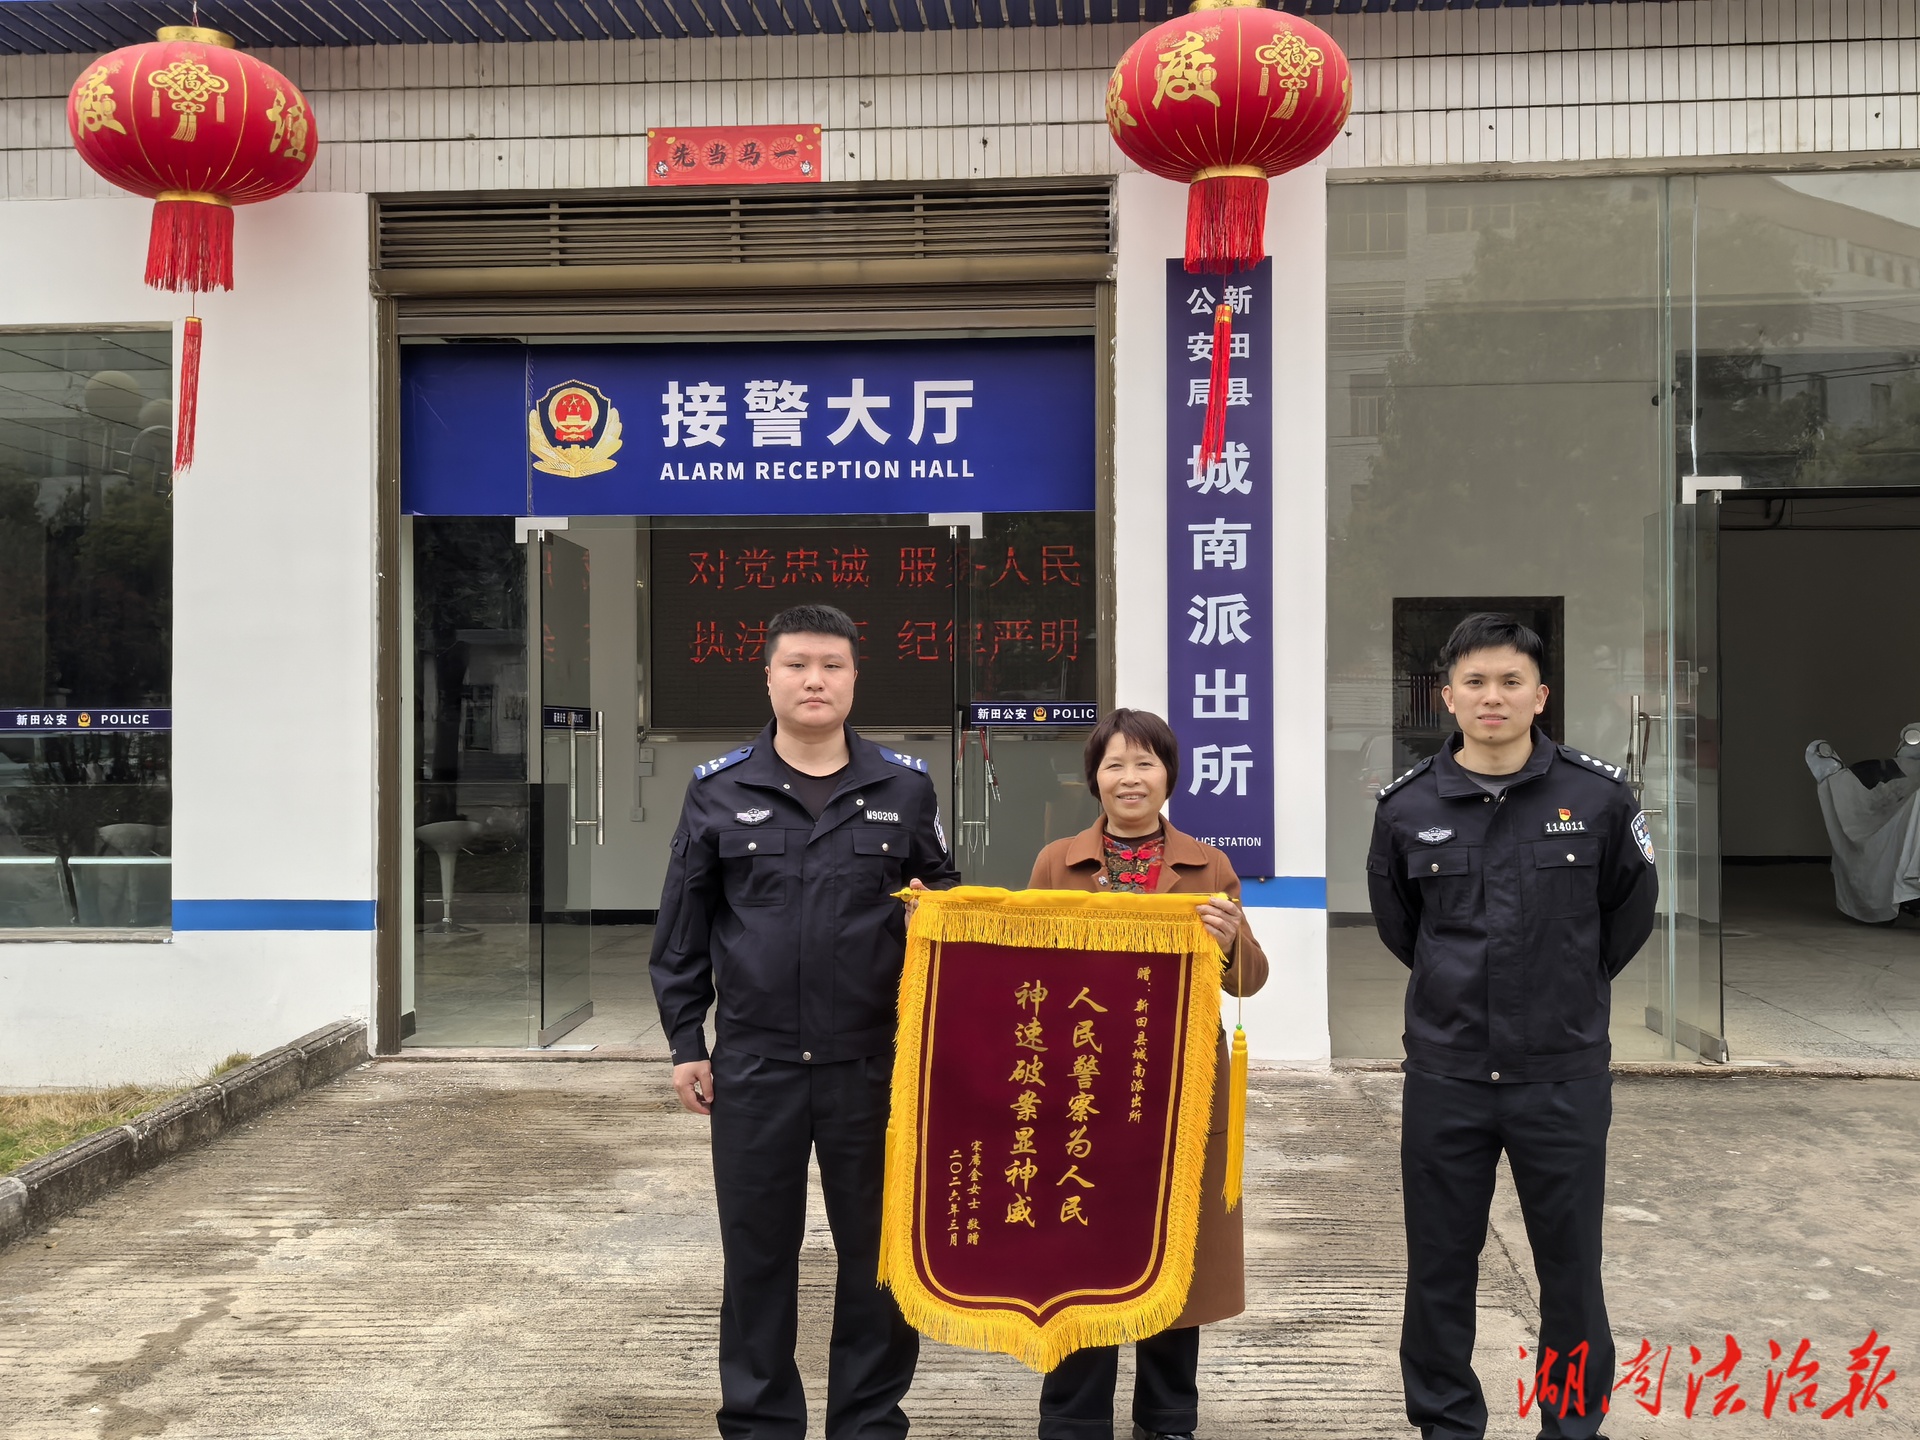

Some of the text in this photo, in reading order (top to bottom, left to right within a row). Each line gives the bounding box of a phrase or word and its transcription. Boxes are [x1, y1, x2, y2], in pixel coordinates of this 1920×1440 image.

[1283, 43, 1303, 66] 福
[176, 68, 201, 91] 福
[661, 378, 974, 448] 接警大厅
[659, 459, 974, 481] ALARM RECEPTION HALL
[688, 543, 870, 590] 对党忠诚
[1186, 441, 1254, 796] 城南派出所
[16, 713, 67, 726] 新田公安
[101, 714, 150, 725] POLICE
[977, 707, 1027, 720] 新田公安
[1053, 708, 1097, 719] POLIC
[866, 809, 899, 822] M90209
[1545, 821, 1586, 833] 114011
[1218, 837, 1262, 847] STATION
[1128, 998, 1150, 1124] 新田县城南派出所
[1004, 979, 1049, 1228] 神速破案显神威
[1056, 986, 1108, 1226] 人民警察为人民
